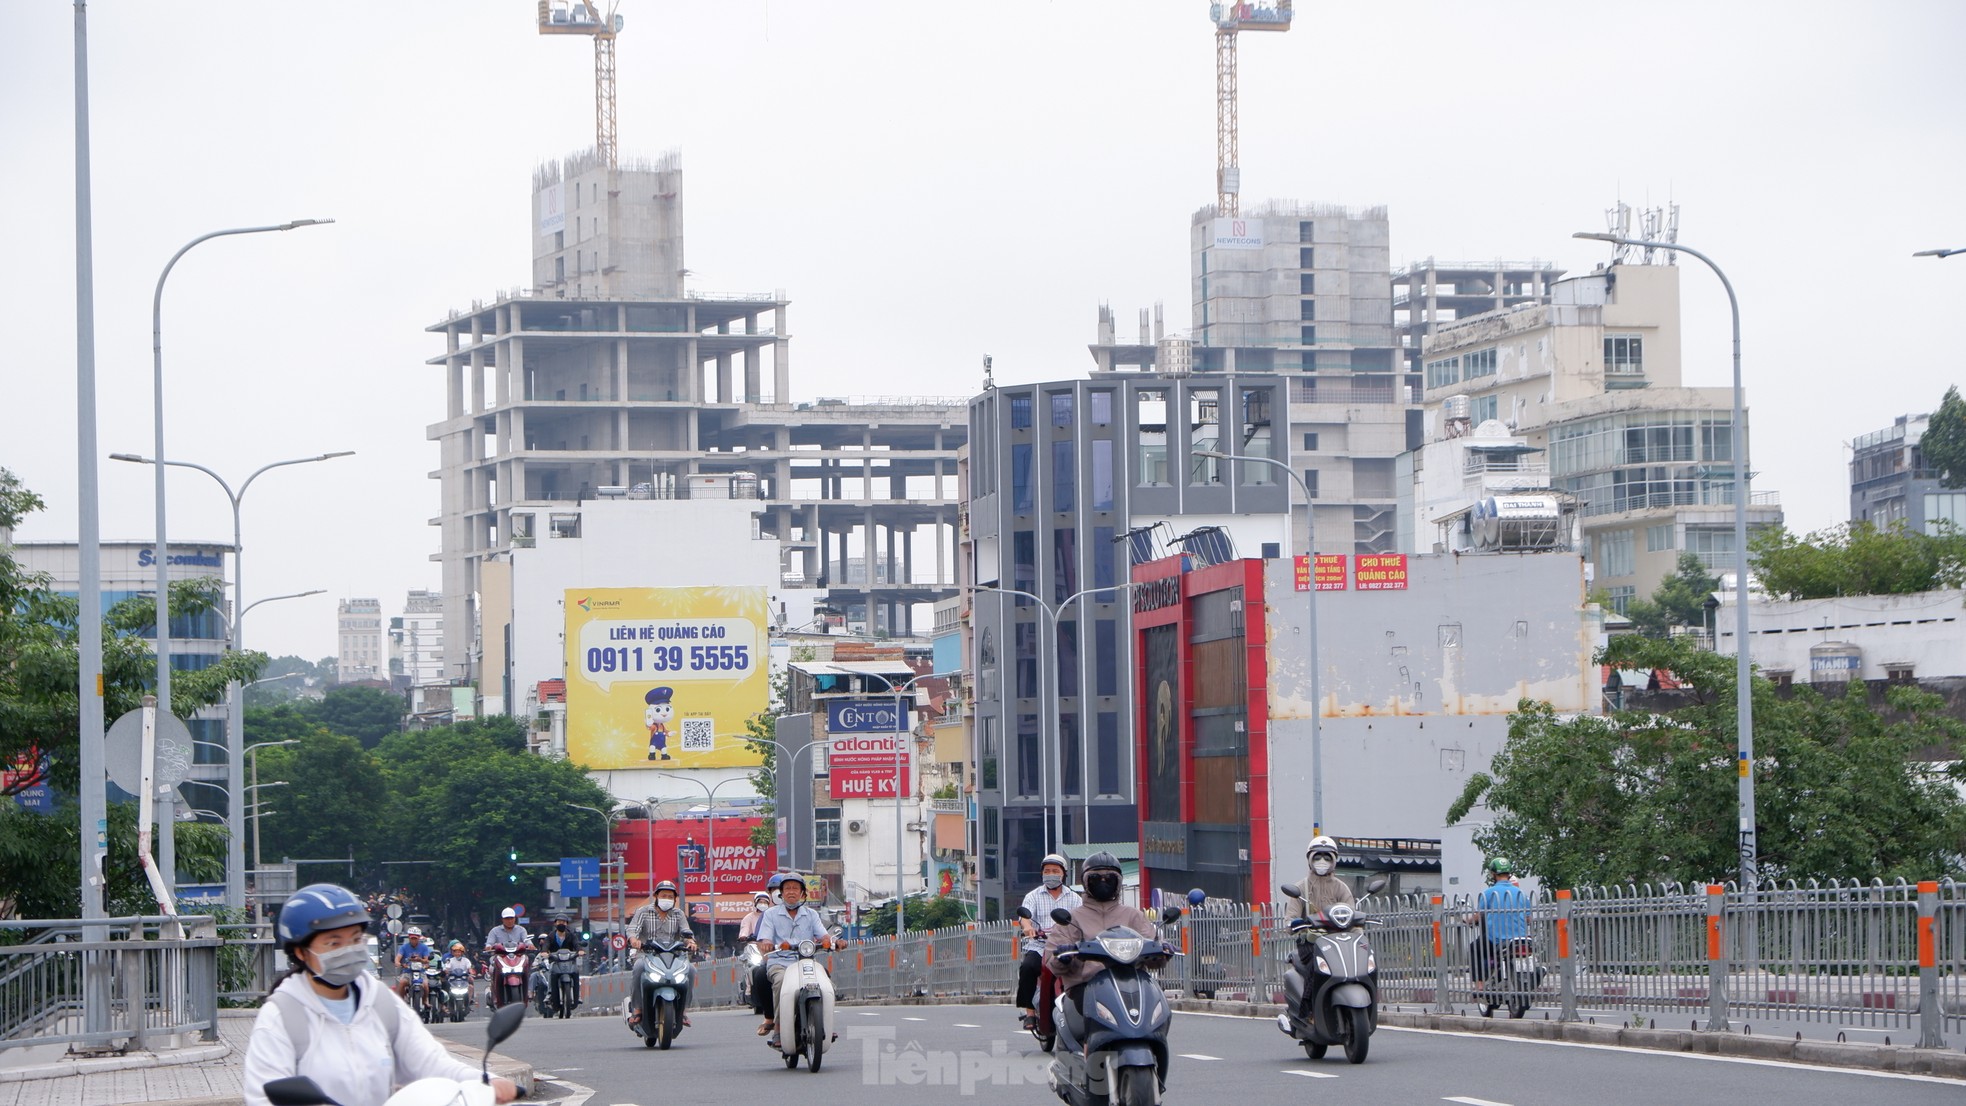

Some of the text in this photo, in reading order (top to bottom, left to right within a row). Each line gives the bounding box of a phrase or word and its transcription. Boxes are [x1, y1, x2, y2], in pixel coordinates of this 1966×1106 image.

[1320, 556, 1338, 564] THUÊ
[1361, 556, 1401, 567] CHO THUÊ
[1358, 569, 1406, 581] QUẢNG CÁO
[609, 623, 726, 643] LIÊN HỆ QUẢNG CÁO
[587, 645, 749, 673] 0911 39 5555
[833, 736, 906, 751] atlantic
[842, 776, 873, 796] HUỆ
[707, 846, 766, 858] NIPPON
[713, 858, 759, 870] PAINT
[721, 874, 742, 883] Cũng
[745, 873, 763, 883] Đẹp
